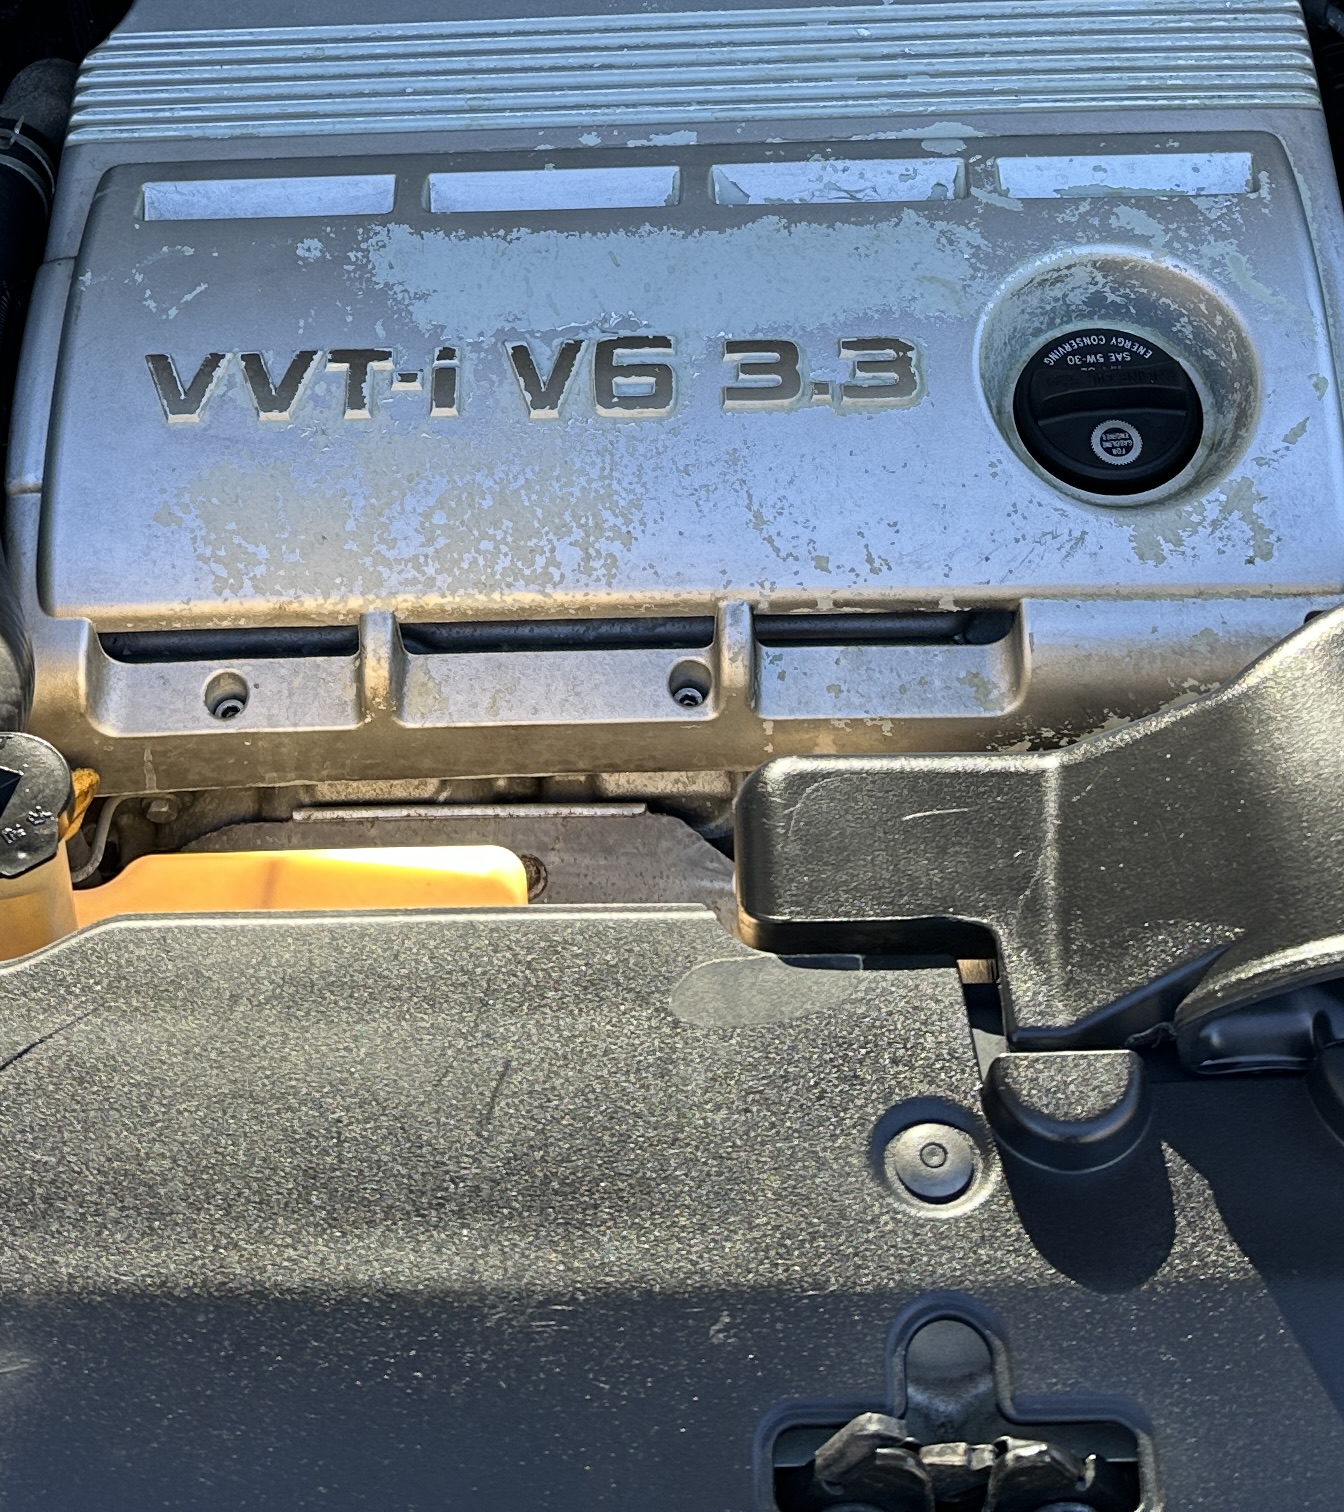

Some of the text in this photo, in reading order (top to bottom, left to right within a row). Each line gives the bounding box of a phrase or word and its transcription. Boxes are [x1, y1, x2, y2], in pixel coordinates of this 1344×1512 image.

[1043, 335, 1153, 366] ENERGY CONSERVING
[1067, 352, 1131, 365] SAE 5W-30
[144, 336, 927, 424] VVT-i V6 3.3
